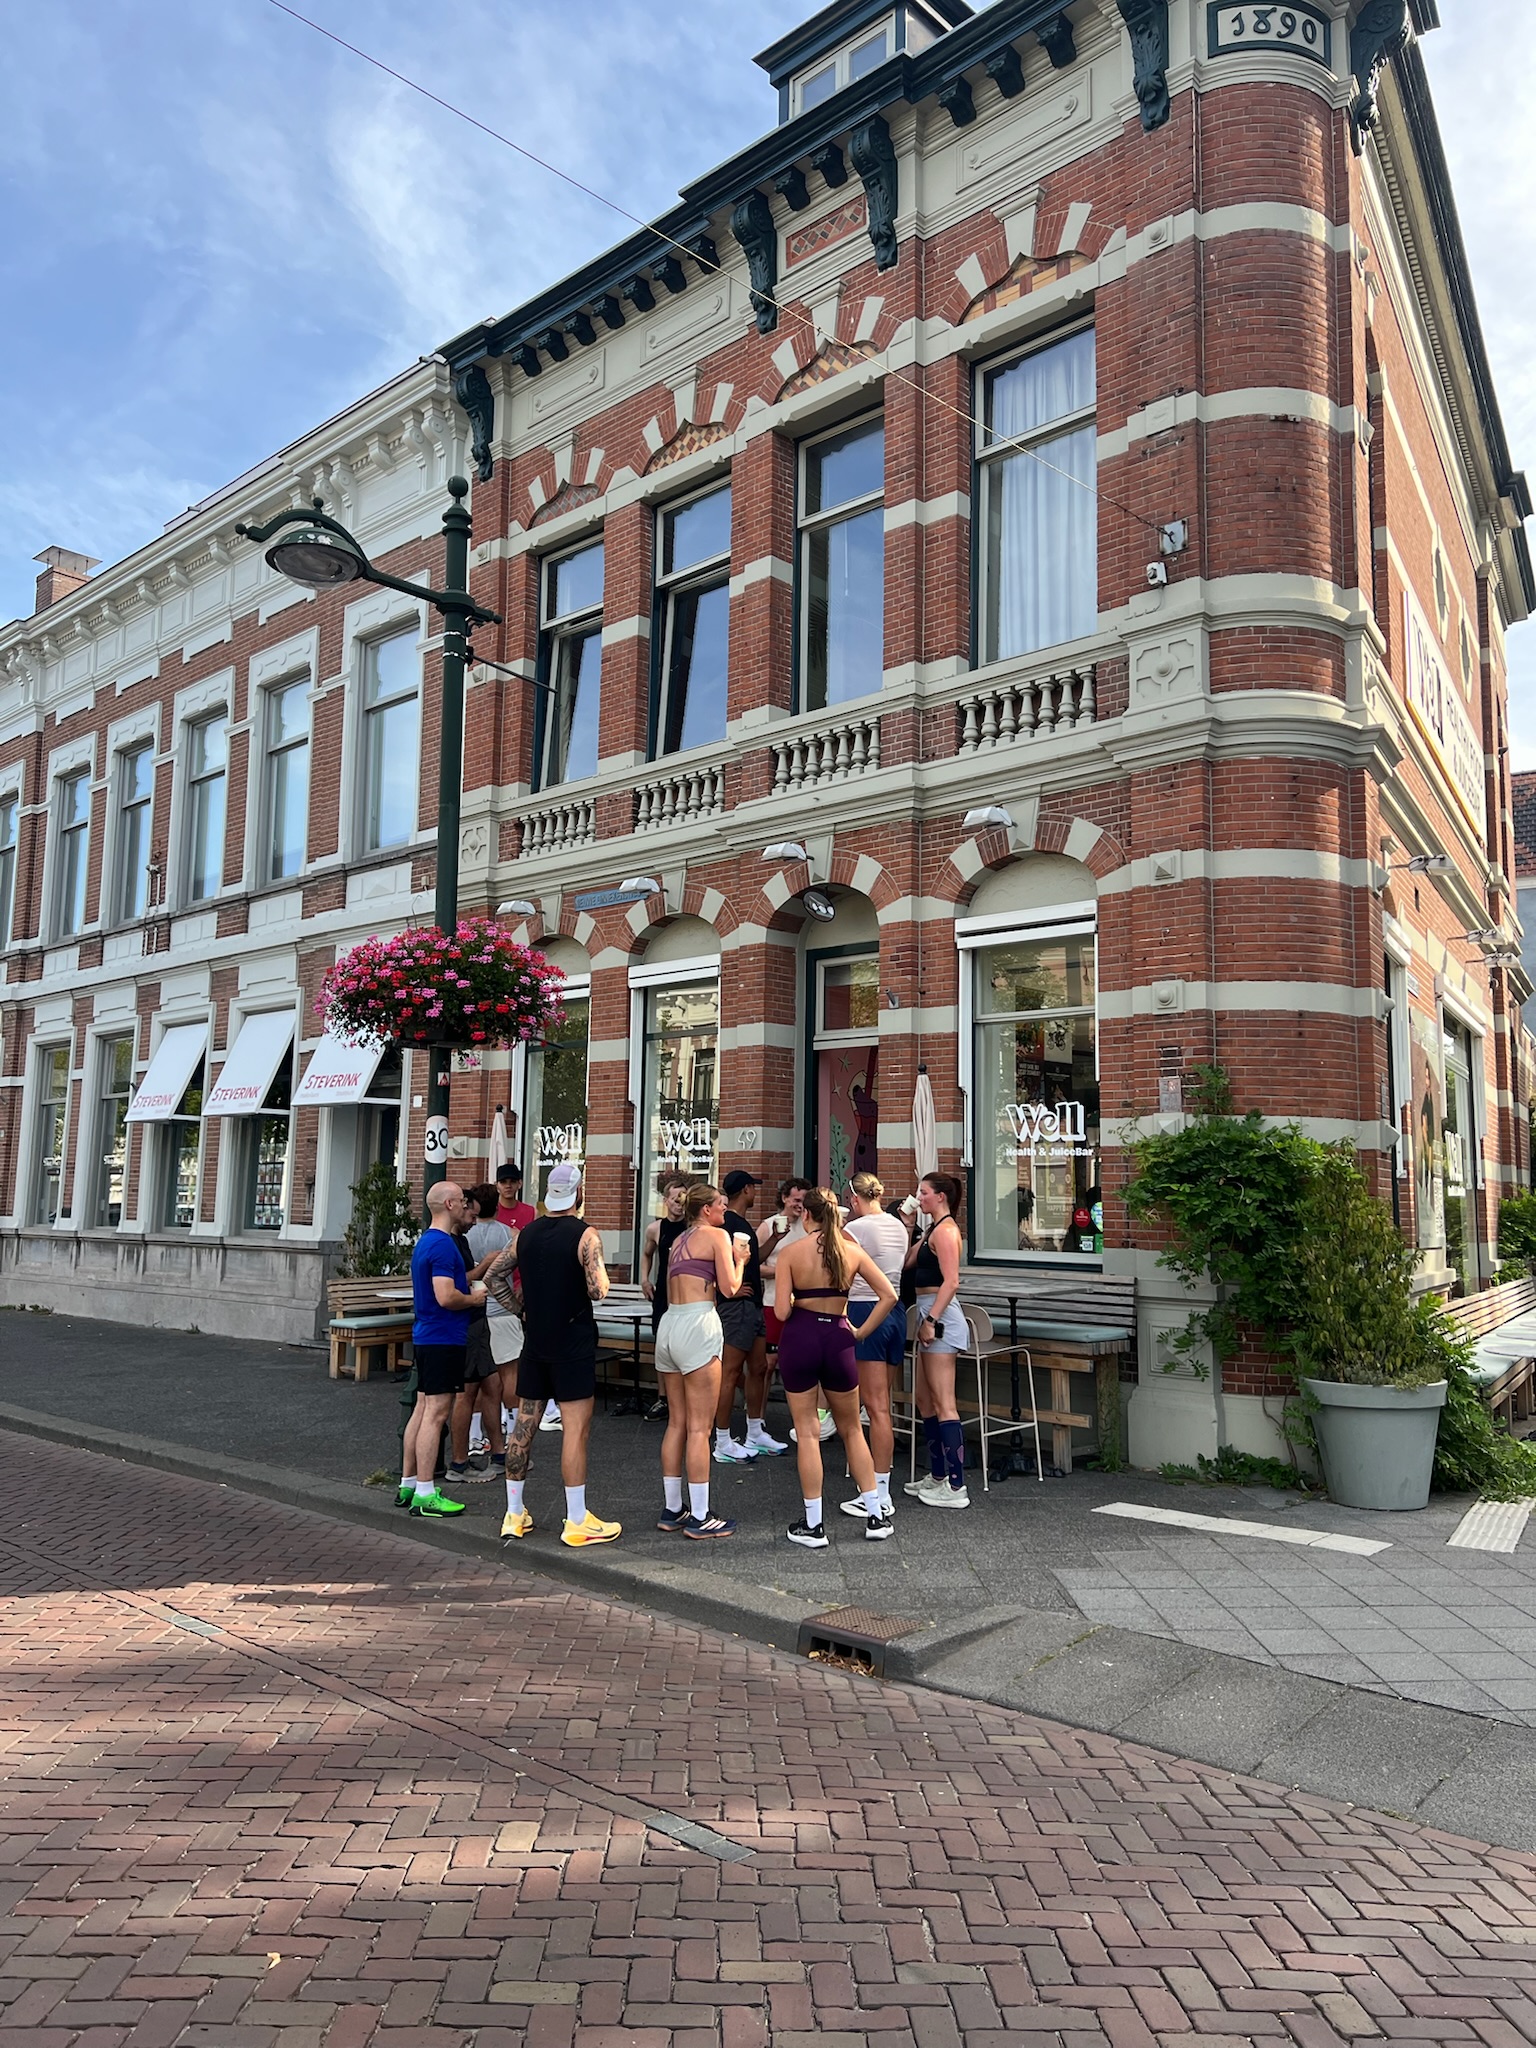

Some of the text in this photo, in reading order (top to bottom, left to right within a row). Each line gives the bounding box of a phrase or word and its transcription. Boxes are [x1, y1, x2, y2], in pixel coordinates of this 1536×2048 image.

[1231, 6, 1317, 45] 1890
[212, 1085, 262, 1102] STEVERINK
[305, 1072, 363, 1090] STEVERINK
[133, 1093, 176, 1109] STEVERINK
[1005, 1101, 1086, 1142] Well
[426, 1127, 449, 1152] 30
[538, 1123, 583, 1156] Well
[658, 1117, 711, 1152] Well
[1005, 1147, 1037, 1157] Health
[1038, 1147, 1047, 1156] &
